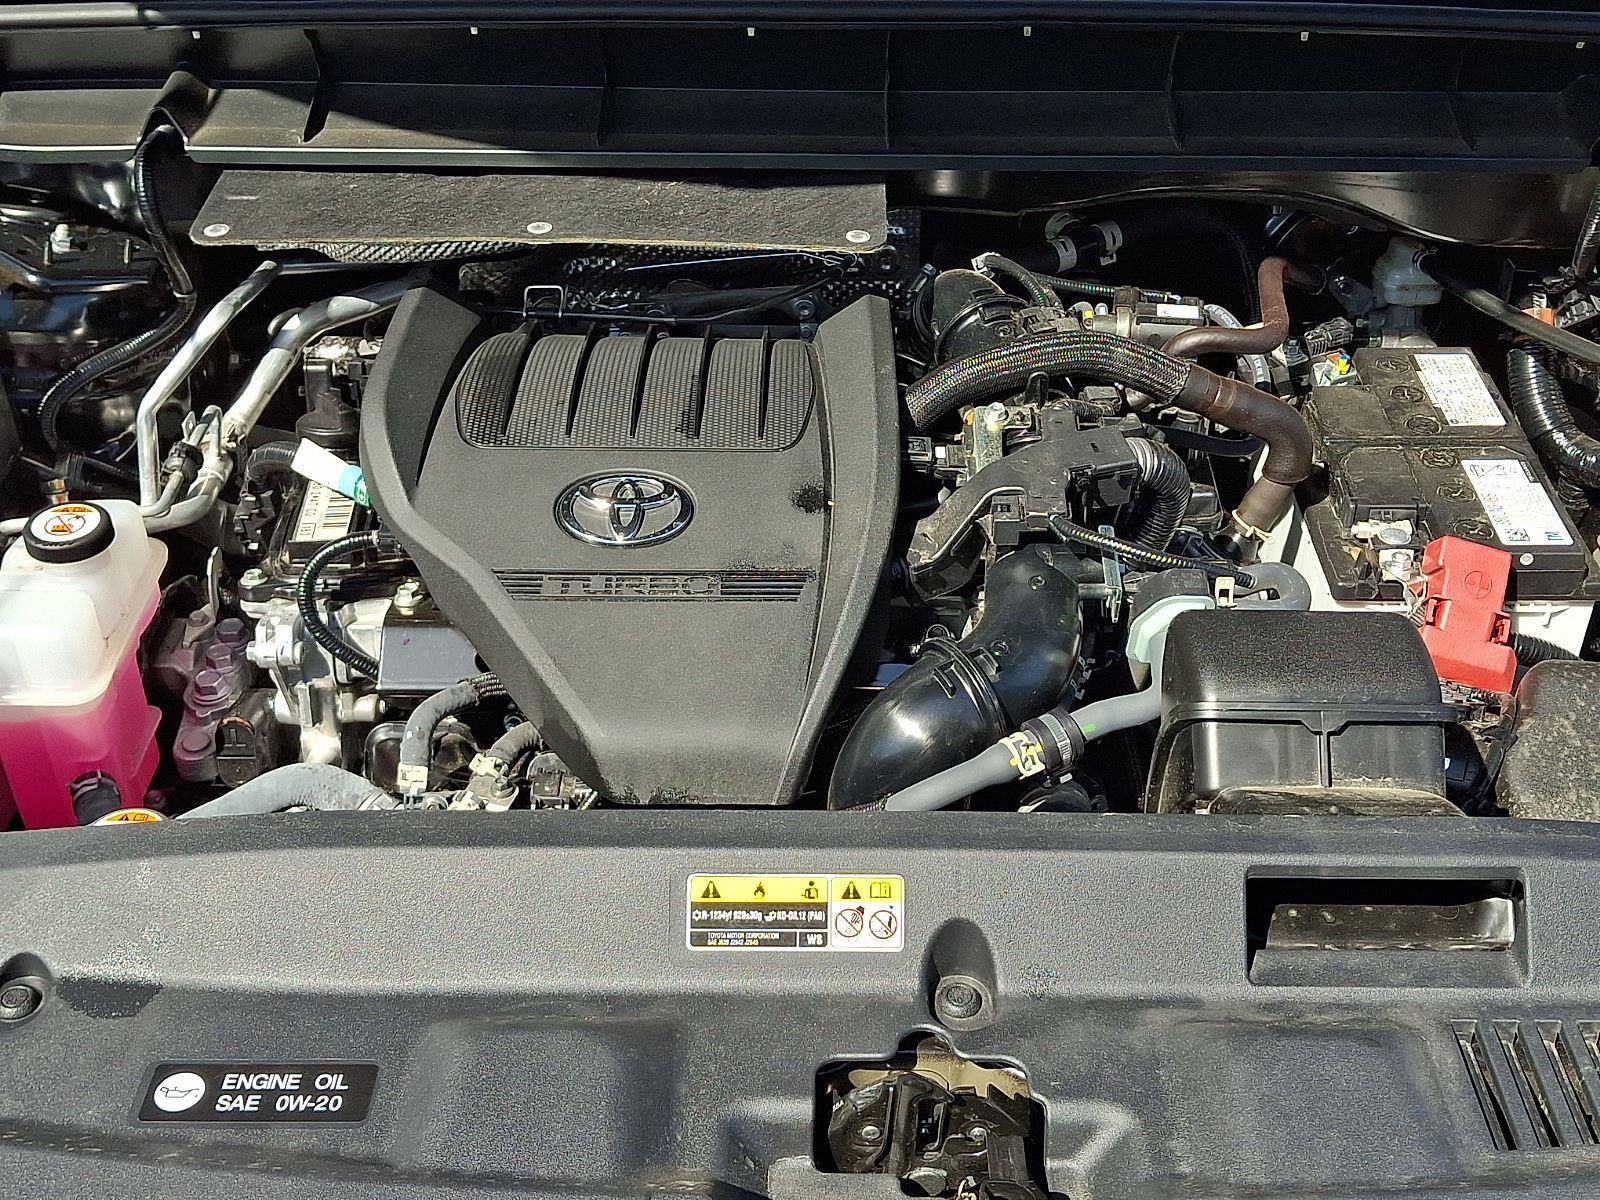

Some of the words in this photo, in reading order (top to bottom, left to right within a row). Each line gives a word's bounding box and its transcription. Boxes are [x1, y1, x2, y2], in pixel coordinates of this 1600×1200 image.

[547, 576, 718, 596] TURBO
[745, 932, 780, 940] CORPORATION
[221, 1073, 303, 1090] ENGINE
[313, 1073, 350, 1090] OIL
[214, 1094, 262, 1112] SAE
[275, 1094, 343, 1112] 0W-20
